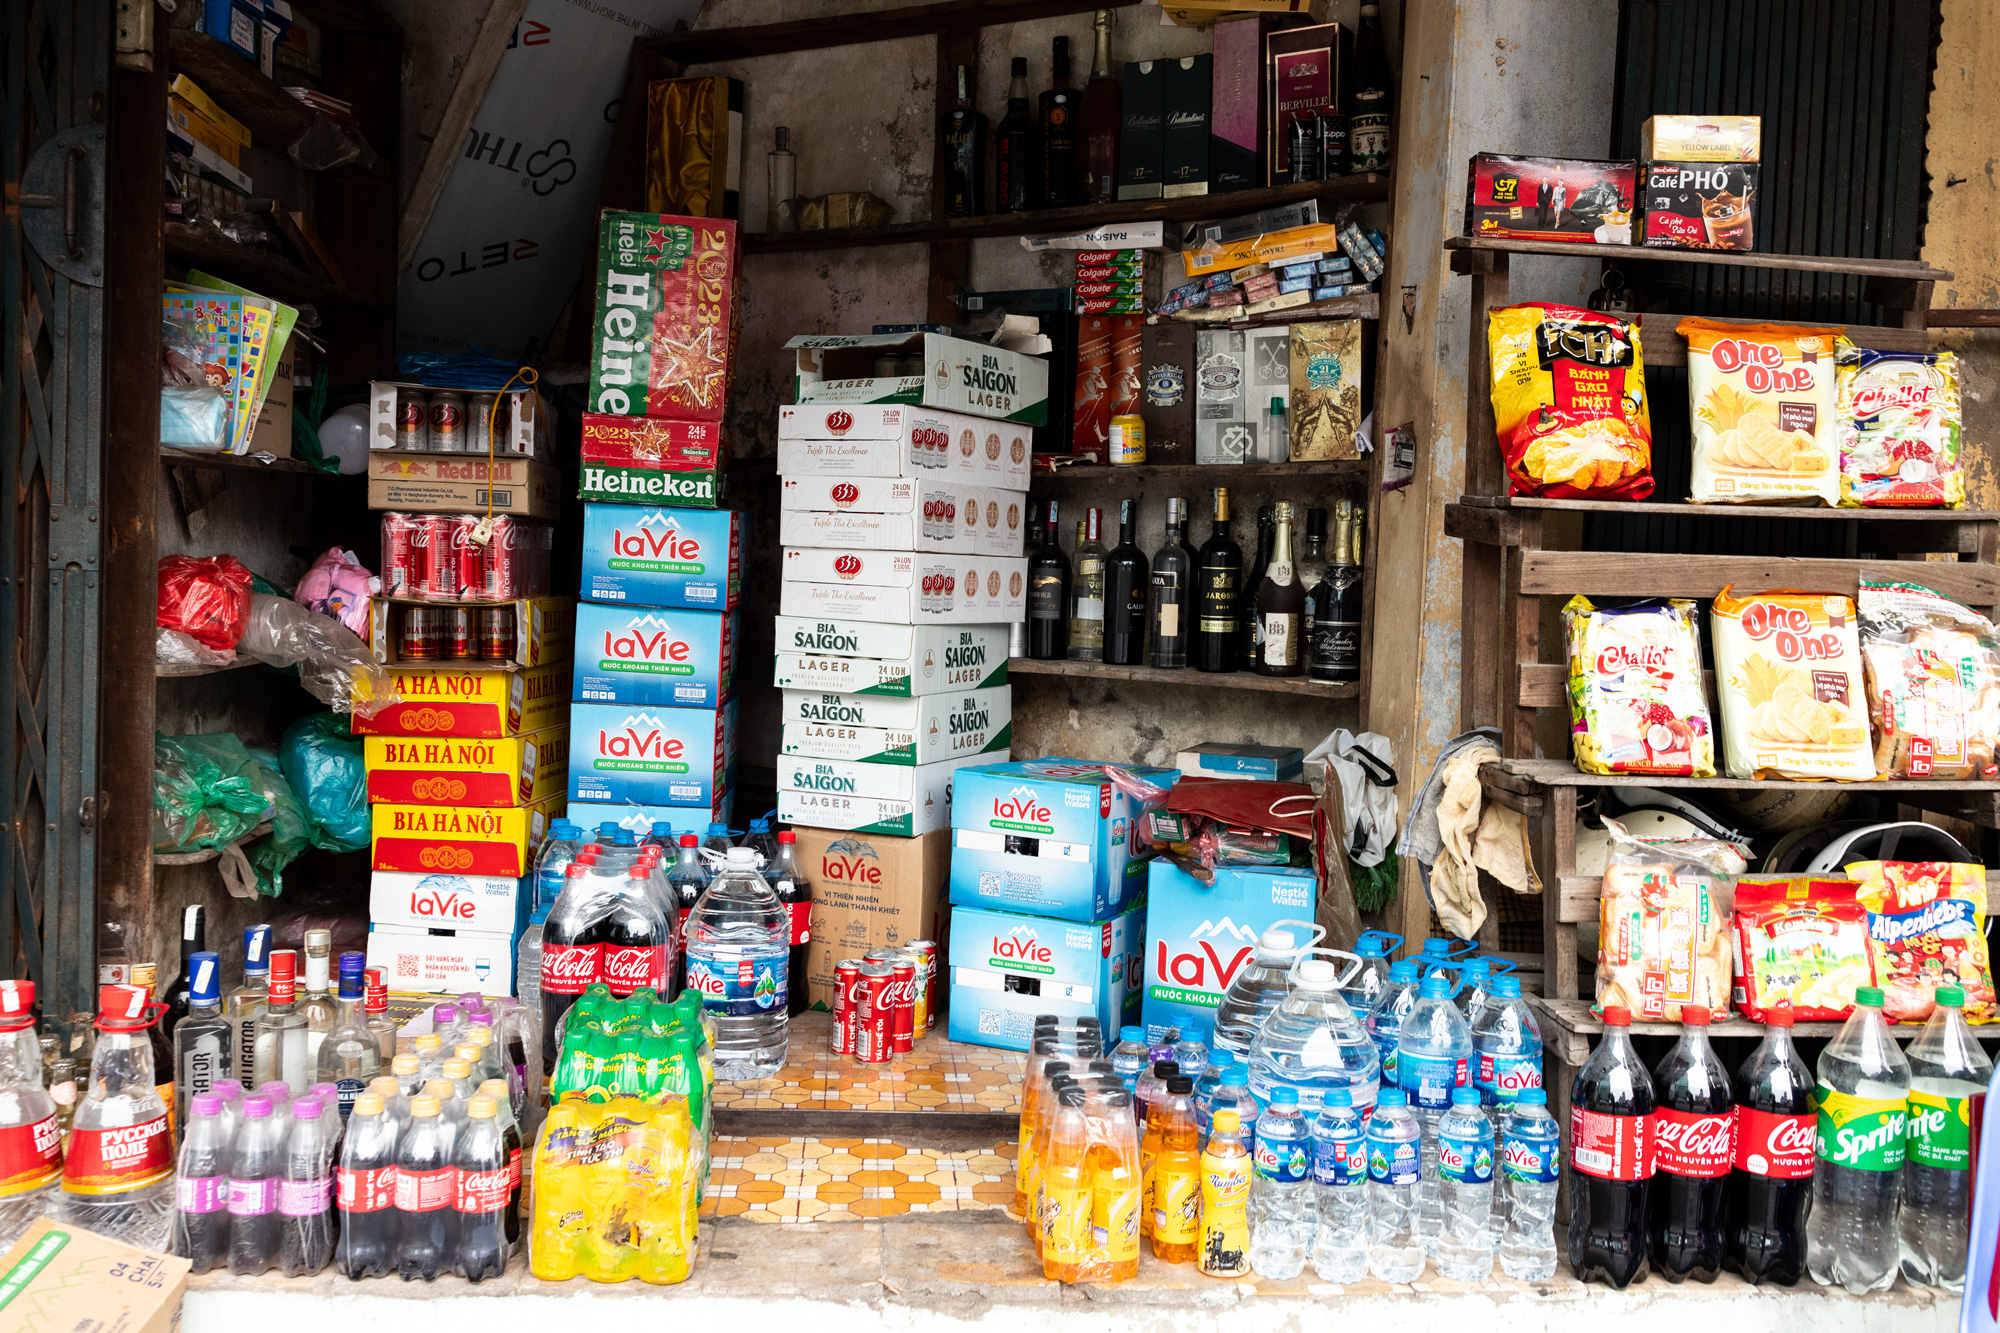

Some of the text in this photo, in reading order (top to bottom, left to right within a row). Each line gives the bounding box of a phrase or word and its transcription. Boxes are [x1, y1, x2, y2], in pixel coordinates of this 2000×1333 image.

[1280, 96, 1329, 112] BERVILLE
[1166, 110, 1205, 124] Ballantine's
[999, 138, 1010, 206] BLAVOD
[1135, 167, 1145, 177] 17
[1179, 165, 1190, 176] 17
[1650, 166, 1729, 190] Café PHỐ
[1480, 219, 1499, 230] 3in1
[1078, 252, 1112, 263] Colgate
[1078, 267, 1112, 279] Colgate
[1078, 283, 1112, 294] Colgate
[982, 354, 999, 370] BIA
[1712, 339, 1784, 373] One
[1319, 364, 1330, 374] 21
[1569, 368, 1610, 381] BÁNH
[963, 365, 1016, 395] SAIGON
[1745, 364, 1816, 393] One
[1575, 381, 1608, 395] GẠO
[968, 390, 1012, 411] LAGER
[1572, 395, 1613, 410] NHẬT
[830, 410, 849, 428] 333
[584, 424, 629, 440] 2023
[688, 426, 700, 435] 24
[807, 445, 869, 457] Triple The Excellence
[436, 460, 512, 481] Red Bull
[583, 468, 713, 499] Heineken
[835, 482, 855, 499] 333
[814, 518, 880, 530] Triple The Excellence
[613, 527, 701, 561] laVie
[612, 560, 701, 573] NƯỚC KHOÁNG THIÊN NHIÊN
[839, 554, 858, 571] 333
[812, 589, 877, 602] Triple The Excellence
[1741, 601, 1810, 639] One
[817, 623, 837, 634] BIA
[604, 629, 690, 662] laVie
[794, 632, 858, 651] SAIGON
[959, 632, 973, 646] BIA
[1775, 631, 1844, 660] One
[945, 645, 986, 668] SAIGON
[603, 661, 621, 669] NƯỚC
[623, 663, 650, 672] KHOÁNG
[671, 666, 691, 674] NHIÊN
[798, 659, 850, 673] LAGER
[878, 665, 906, 676] 24 LON
[948, 668, 982, 684] LAGER
[412, 670, 483, 701] HÀ NỘI
[821, 694, 841, 705] BIA
[963, 698, 976, 711] BIA
[800, 703, 863, 723] SAIGON
[949, 710, 989, 734] SAIGON
[805, 726, 857, 740] LAGER
[885, 733, 913, 743] 24 LON
[599, 728, 684, 760] laVie
[952, 734, 985, 750] LAGER
[384, 740, 495, 769] BIA HÀ NỘI
[597, 760, 685, 772] NƯỚC KHOÁNG THIÊN NHIÊN
[815, 764, 834, 775] BIA
[793, 773, 856, 793] SAIGON
[800, 795, 851, 809] LAGER
[1064, 793, 1091, 802] Nestlé
[1064, 800, 1091, 809] Waters
[878, 803, 906, 813] 24 LON
[993, 797, 1052, 822] laVie
[393, 809, 503, 837] BIA HÀ NỘI
[822, 856, 883, 884] laVie
[485, 882, 510, 890] Nestlé
[485, 888, 510, 896] Waters
[1271, 885, 1309, 898] Nestlé
[410, 891, 476, 918] laVie
[824, 891, 879, 904] VỊ THIÊN NHIÊN
[1271, 894, 1308, 907] Waters
[1871, 900, 1966, 945] Alpenliebe
[1065, 933, 1093, 943] Nestlé
[993, 936, 1052, 962] laVie
[1065, 941, 1092, 950] Waters
[876, 1019, 884, 1030] TÔI
[876, 1050, 884, 1061] TÁI
[657, 1063, 683, 1076] sống
[101, 1117, 167, 1146] РУССКОЕ
[1833, 1109, 1906, 1165] Sprite
[101, 1139, 149, 1161] ПОЛЕ
[1634, 1116, 1644, 1179] TÁI CHẾ TÔI
[1918, 1143, 1930, 1151] CỰC
[1664, 1152, 1673, 1162] VỊ
[1675, 1154, 1713, 1166] NGUYÊN
[1918, 1150, 1930, 1158] CỰC
[1931, 1151, 1944, 1160] ĐÁ
[1773, 1158, 1803, 1167] HƯƠNG
[109, 1262, 131, 1277] 04
[128, 1255, 159, 1283] CHAI
